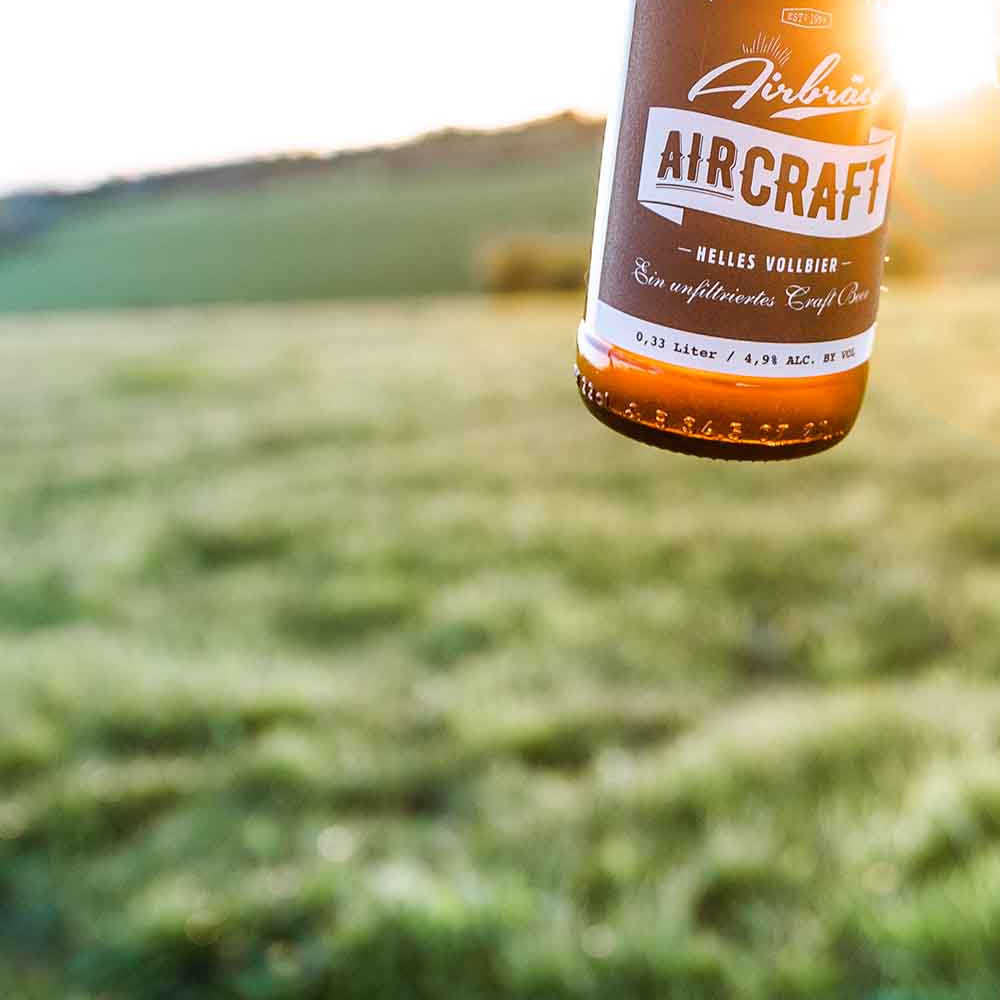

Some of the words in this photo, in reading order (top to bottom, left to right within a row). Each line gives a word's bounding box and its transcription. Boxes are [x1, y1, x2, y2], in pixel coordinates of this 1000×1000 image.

[688, 53, 881, 120] Airbräu
[656, 129, 887, 221] AIRCRAFT
[632, 257, 666, 287] Ein
[670, 279, 775, 308] unfiltriertes
[785, 284, 836, 315] Craft
[696, 245, 756, 270] HELLES
[766, 253, 838, 273] VOLLBIER
[636, 331, 666, 349] 0,33
[673, 342, 718, 360] Liter
[744, 352, 778, 366] 4,9%
[786, 354, 816, 366] ALC.
[823, 352, 836, 363] BY
